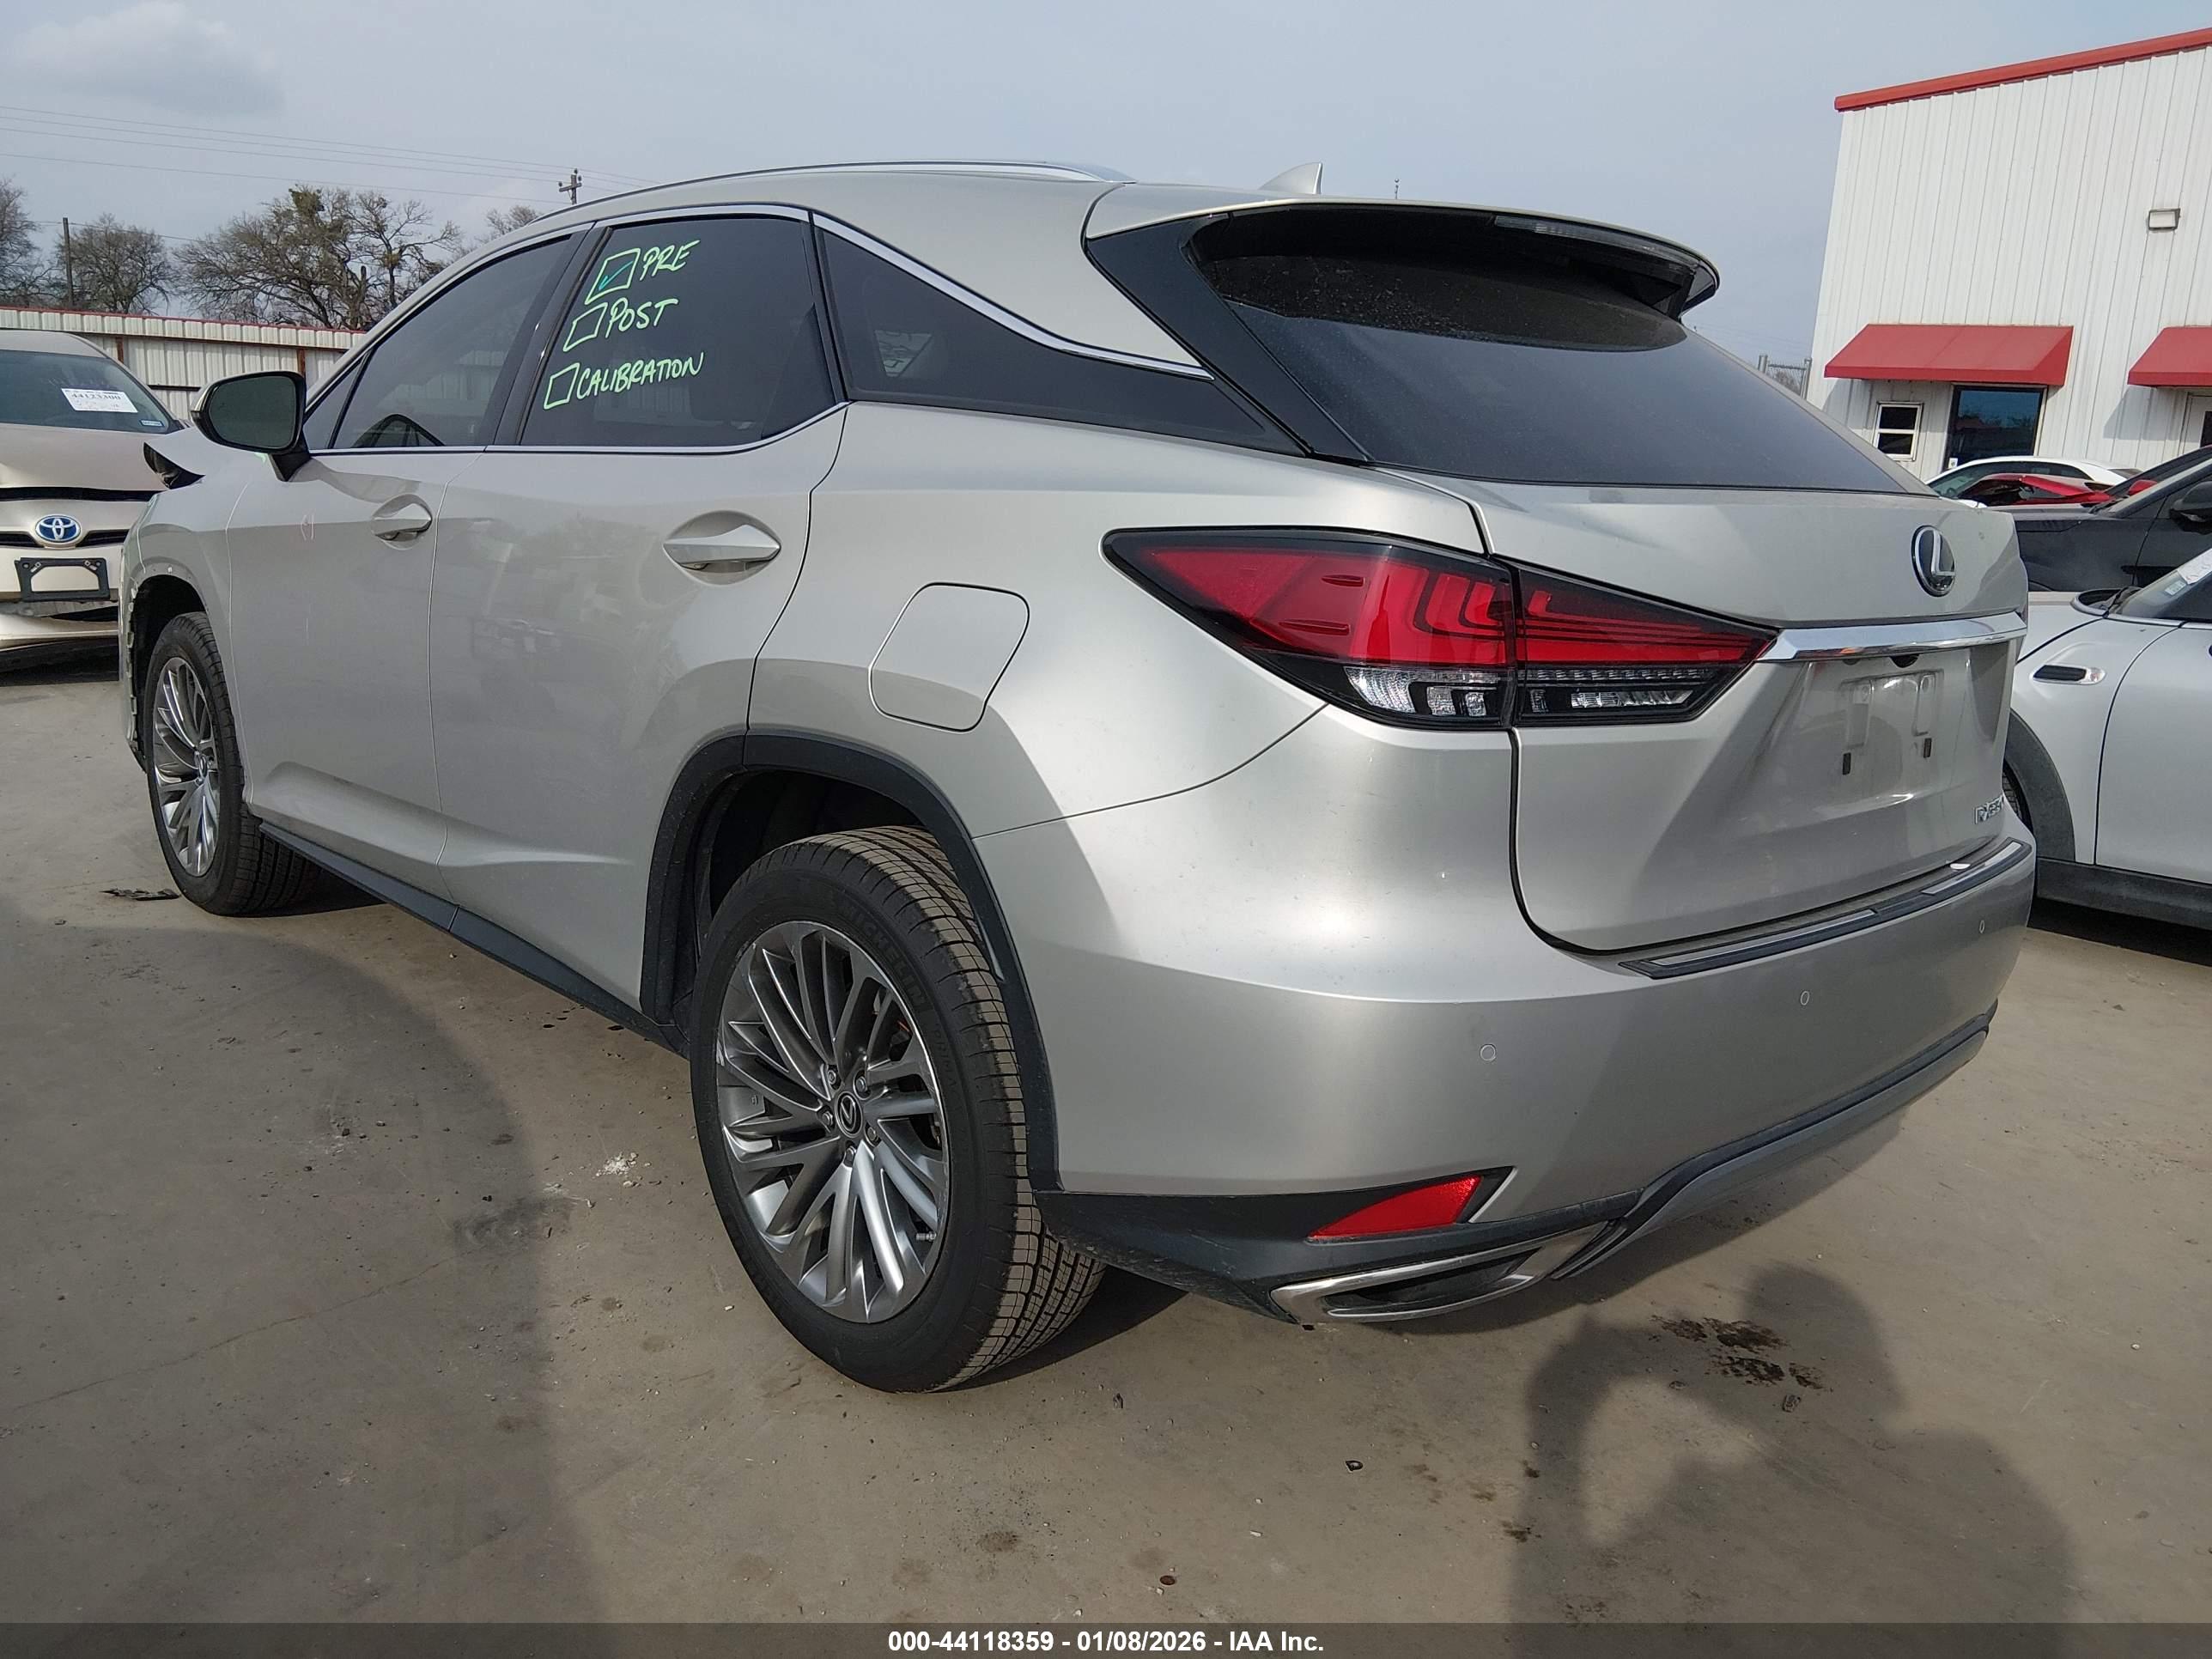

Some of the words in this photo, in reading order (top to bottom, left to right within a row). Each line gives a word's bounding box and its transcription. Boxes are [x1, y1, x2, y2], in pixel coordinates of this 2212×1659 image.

[640, 240, 700, 282] PRE
[605, 297, 679, 338] POST
[576, 352, 704, 399] CALIBRATION
[838, 896, 927, 1006] MICHELIN
